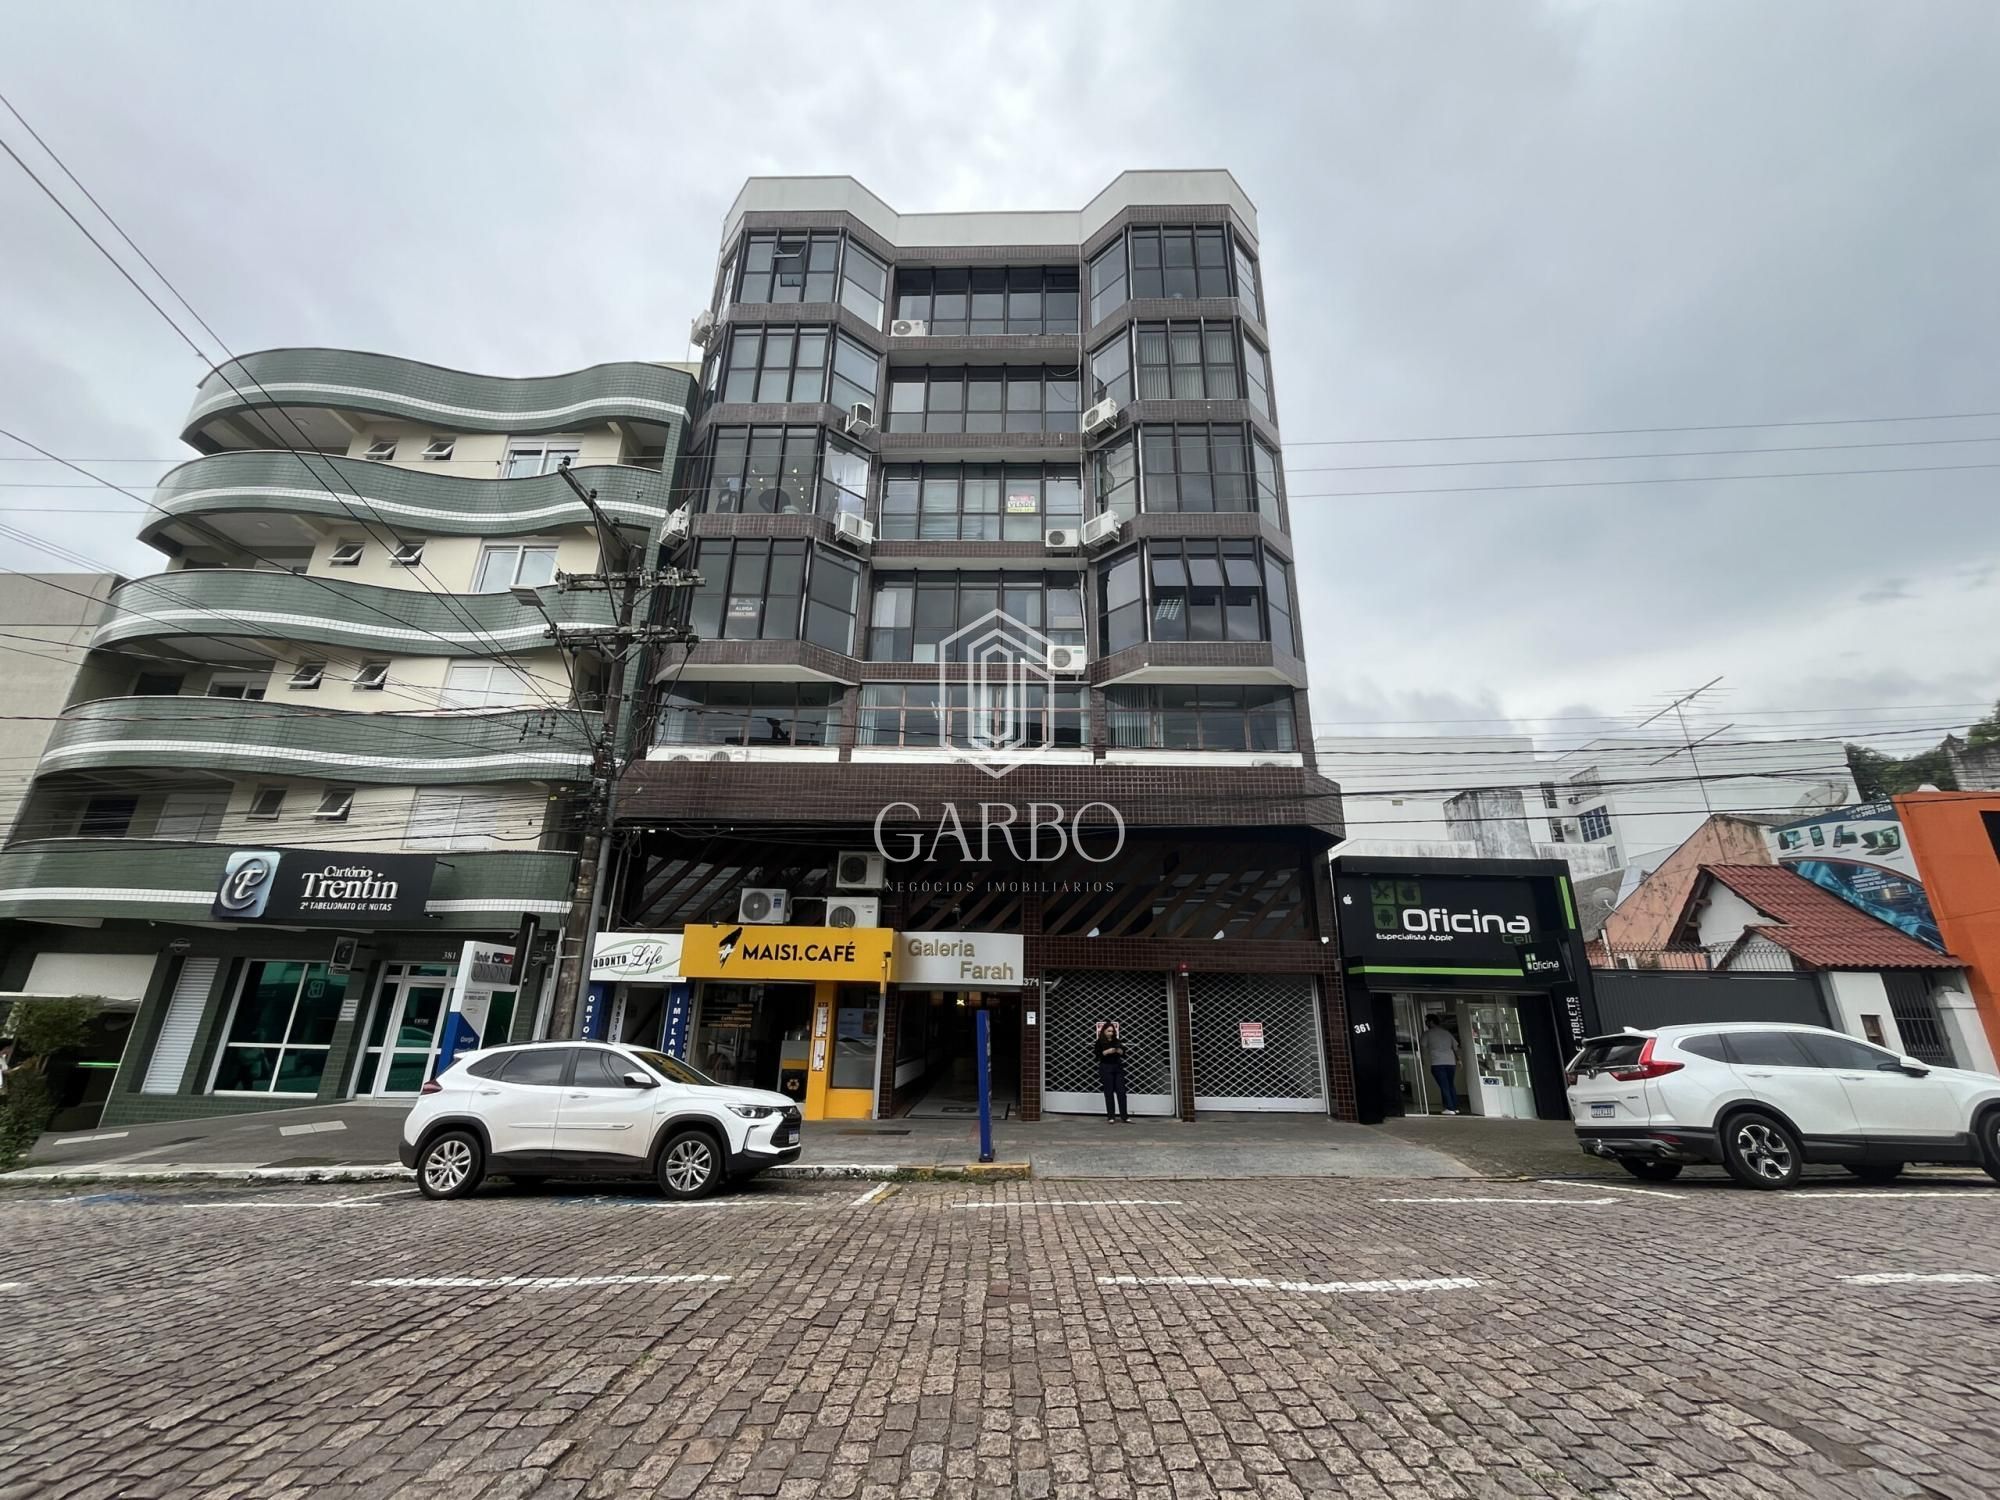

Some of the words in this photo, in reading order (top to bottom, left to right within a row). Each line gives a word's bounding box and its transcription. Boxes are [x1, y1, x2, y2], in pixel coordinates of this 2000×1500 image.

[324, 865, 374, 878] Cartório
[301, 873, 399, 899] Trentin
[310, 902, 356, 910] TABELIONATO
[369, 903, 393, 911] NOTAS
[1402, 908, 1531, 934] Oficina
[1376, 933, 1427, 941] Especialista
[1429, 933, 1454, 942] Apple
[742, 941, 856, 963] MAIS1.CAFÉ
[907, 938, 975, 958] Galeria
[593, 955, 627, 968] ODONTO
[629, 945, 663, 975] Life
[1533, 960, 1560, 970] Oficina
[960, 961, 1014, 981] Farah
[1023, 978, 1040, 987] 371
[581, 995, 595, 1041] ORTO
[1353, 1022, 1371, 1034] 361
[1566, 996, 1583, 1041] TABLETS
